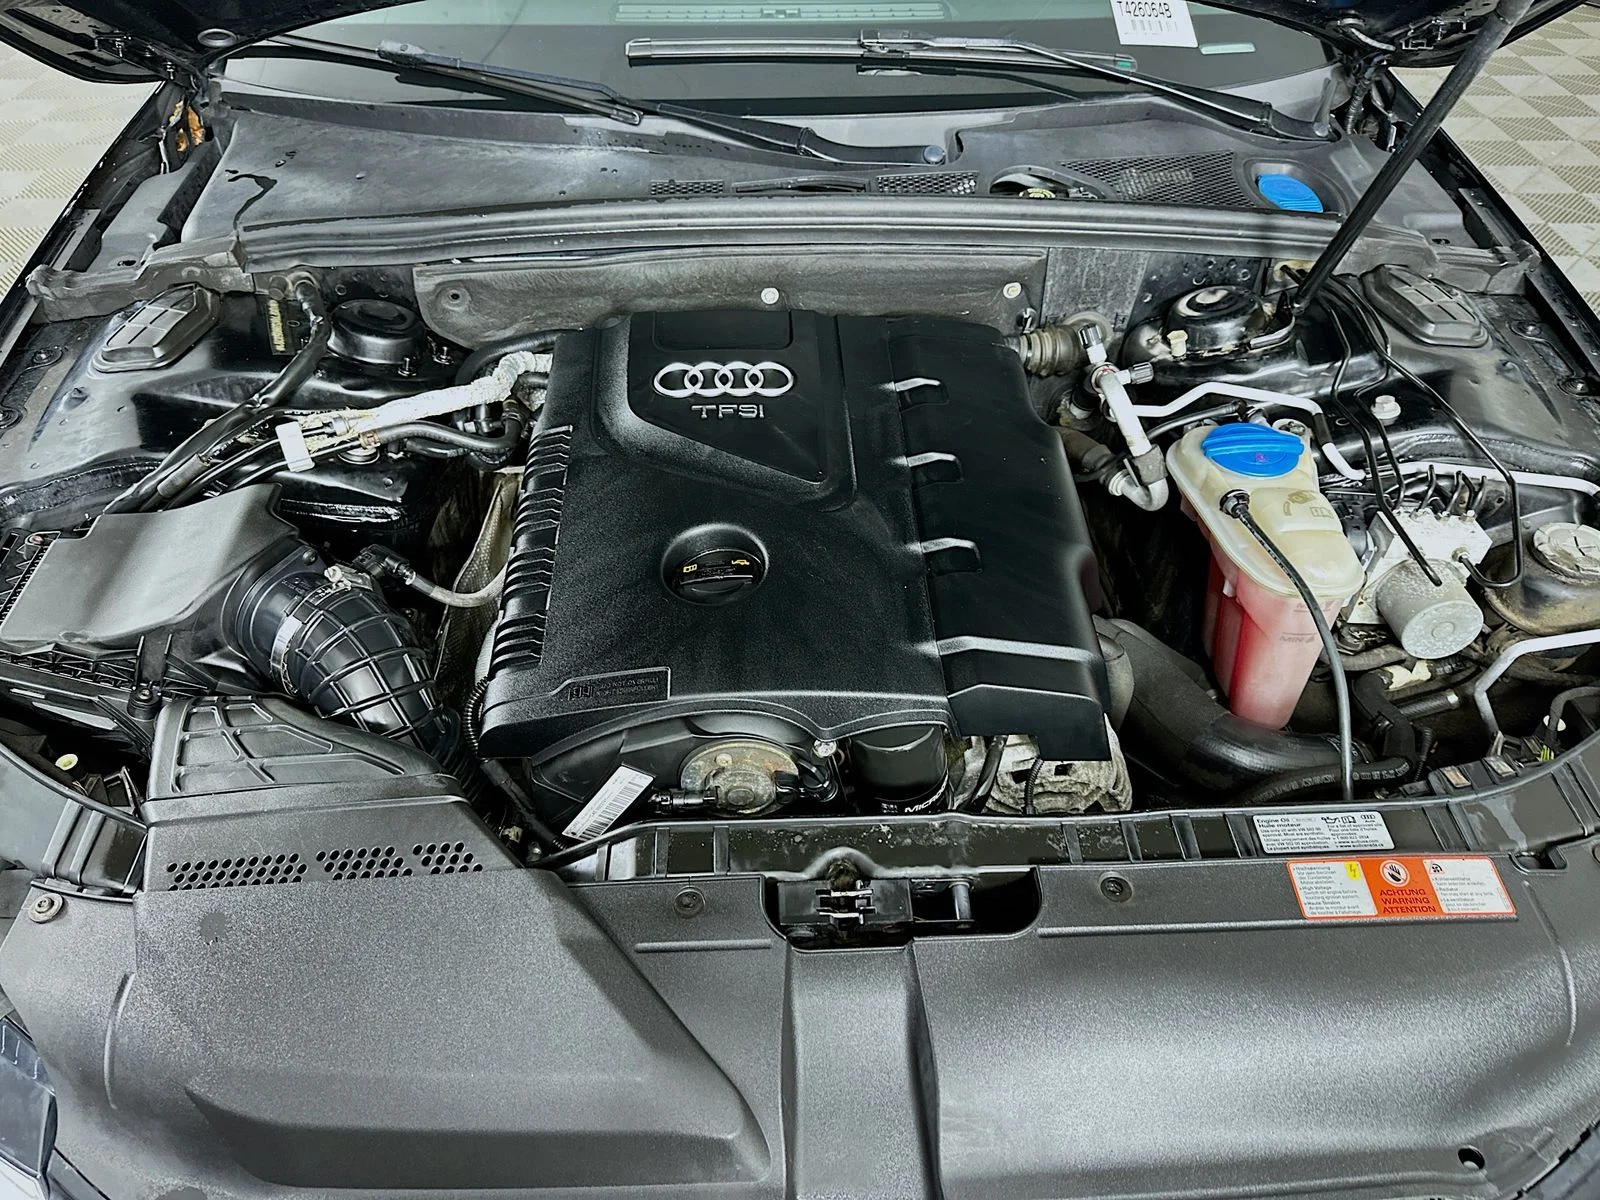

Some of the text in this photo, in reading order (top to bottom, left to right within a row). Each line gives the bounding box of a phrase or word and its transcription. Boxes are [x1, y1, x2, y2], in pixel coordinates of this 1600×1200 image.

[691, 404, 765, 419] TFSI
[1379, 888, 1427, 896] ACHTUNG
[1381, 897, 1430, 905] WARNING
[1383, 905, 1437, 914] ATTENTION
